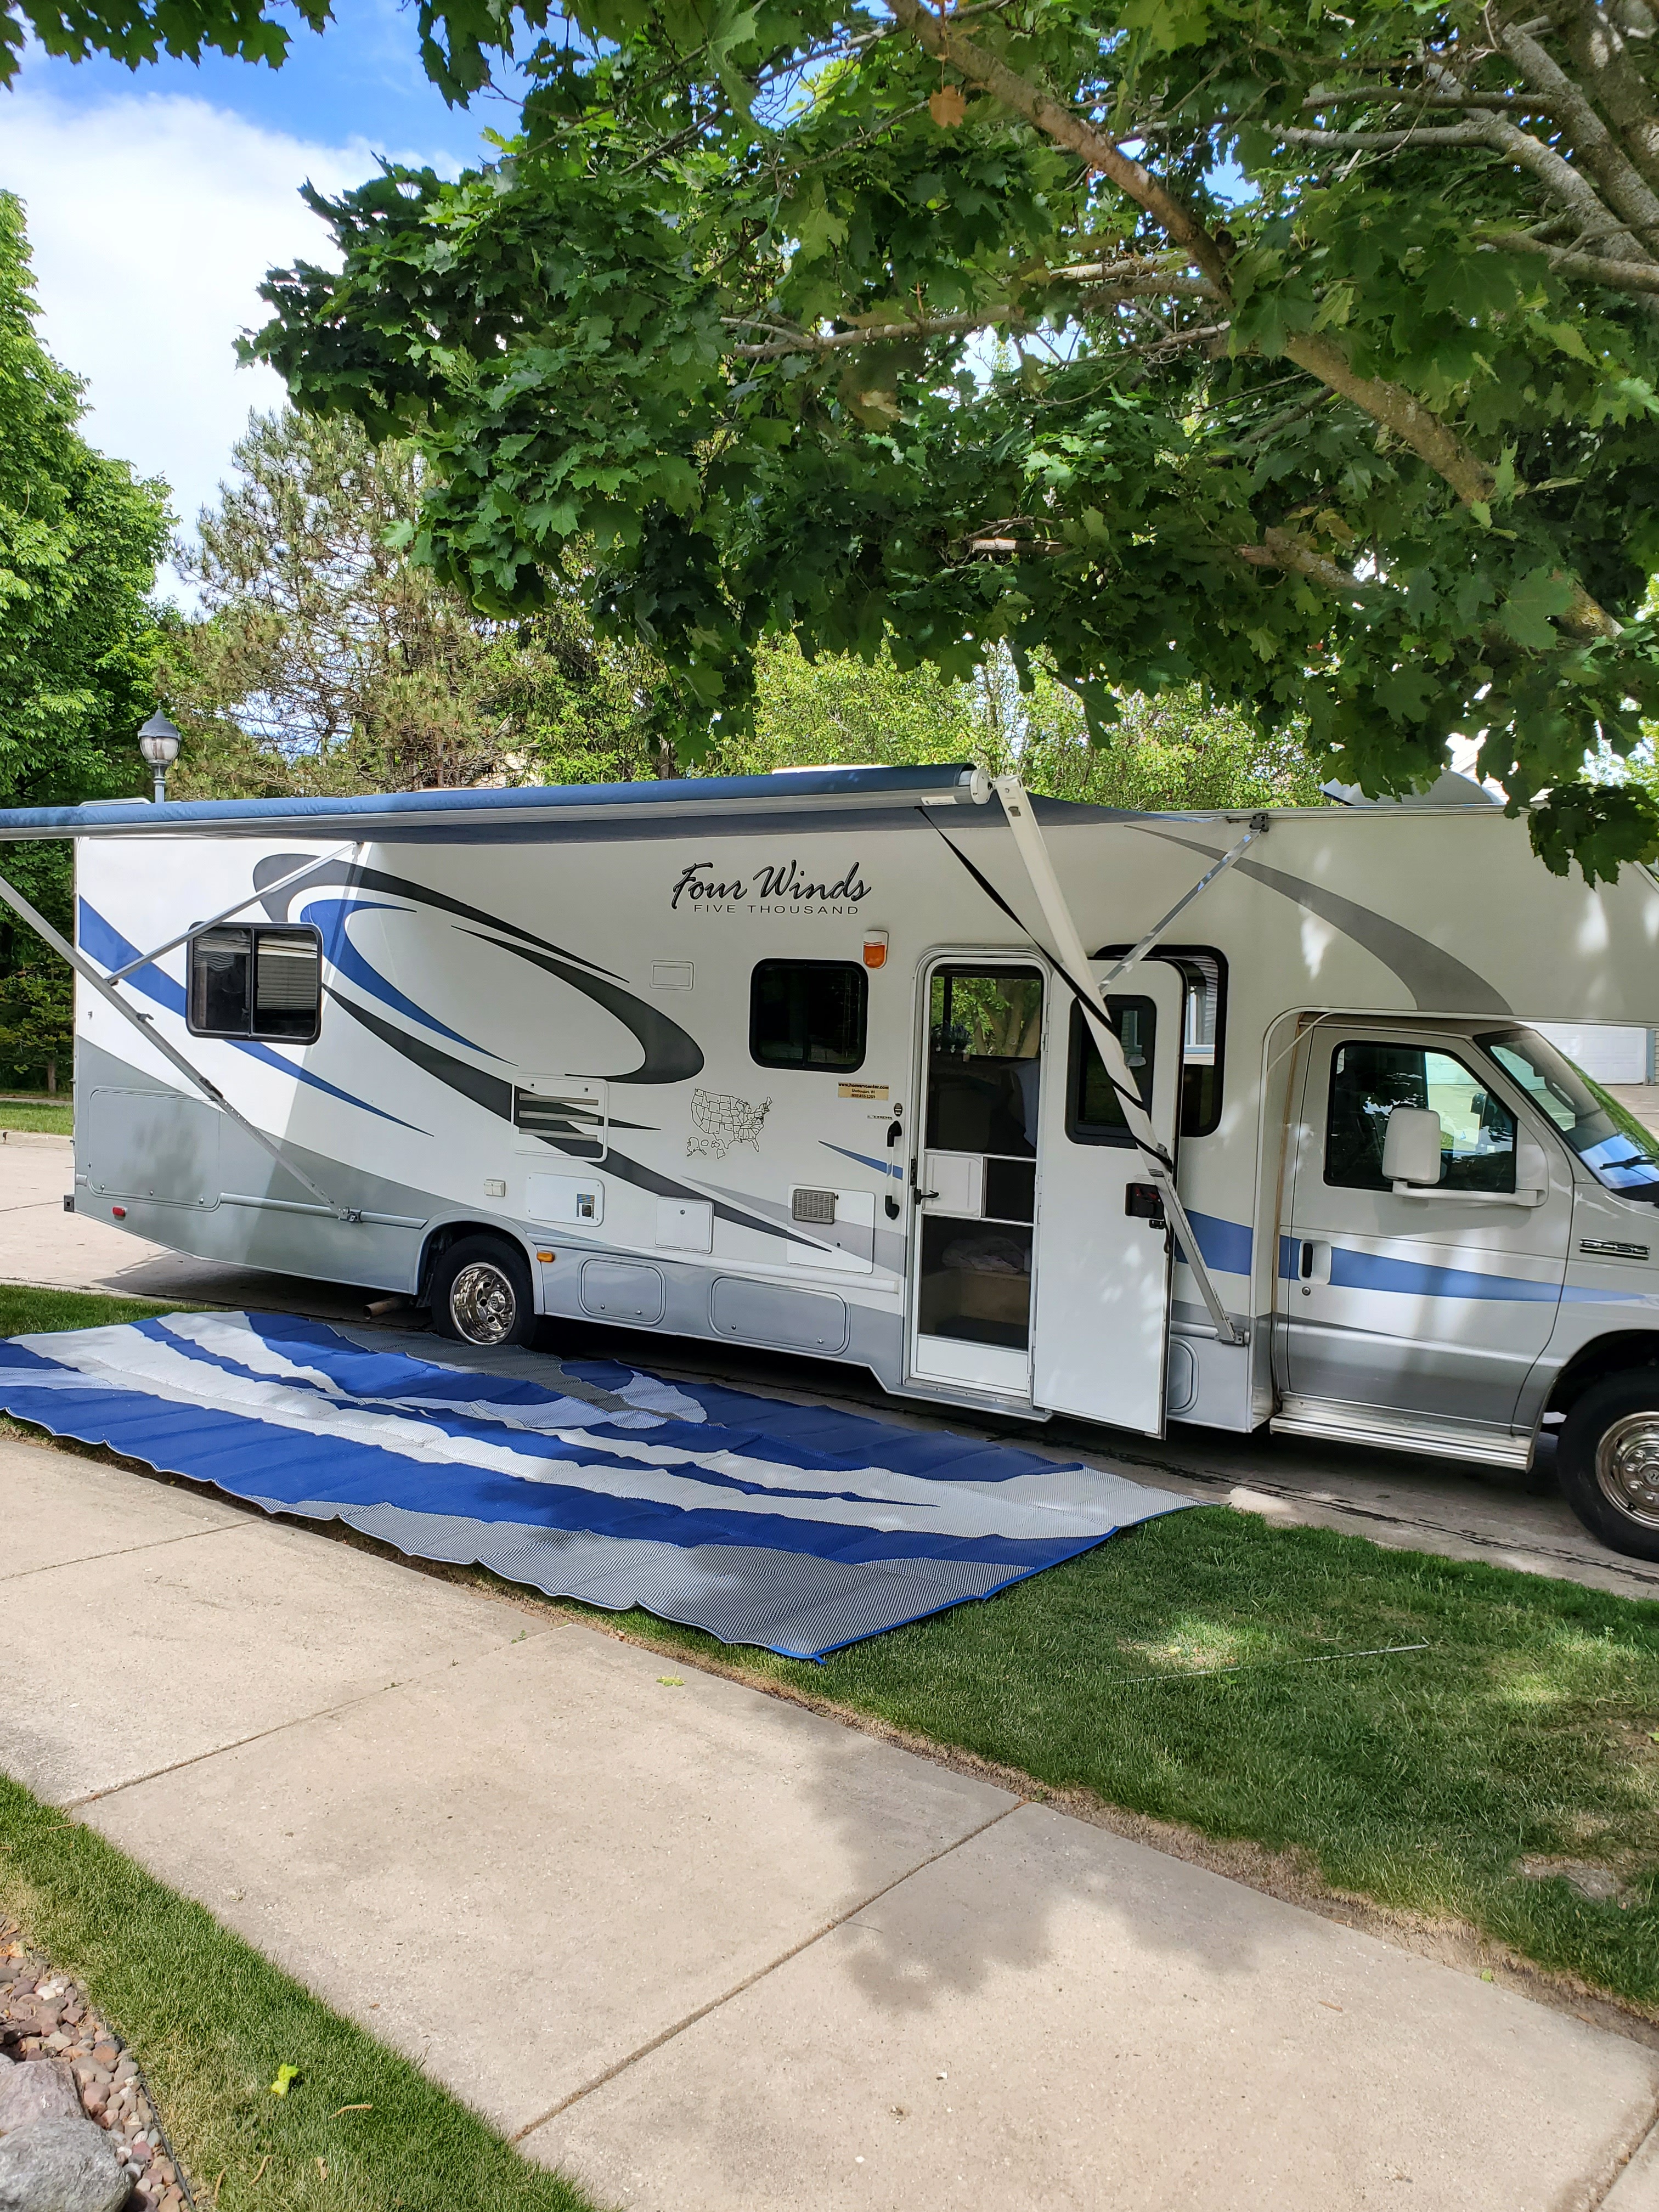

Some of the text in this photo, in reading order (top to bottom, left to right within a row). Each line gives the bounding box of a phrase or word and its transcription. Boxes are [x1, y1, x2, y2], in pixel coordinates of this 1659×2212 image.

[672, 859, 872, 910] Four Winds
[693, 904, 859, 915] FIVE THOUSAND
